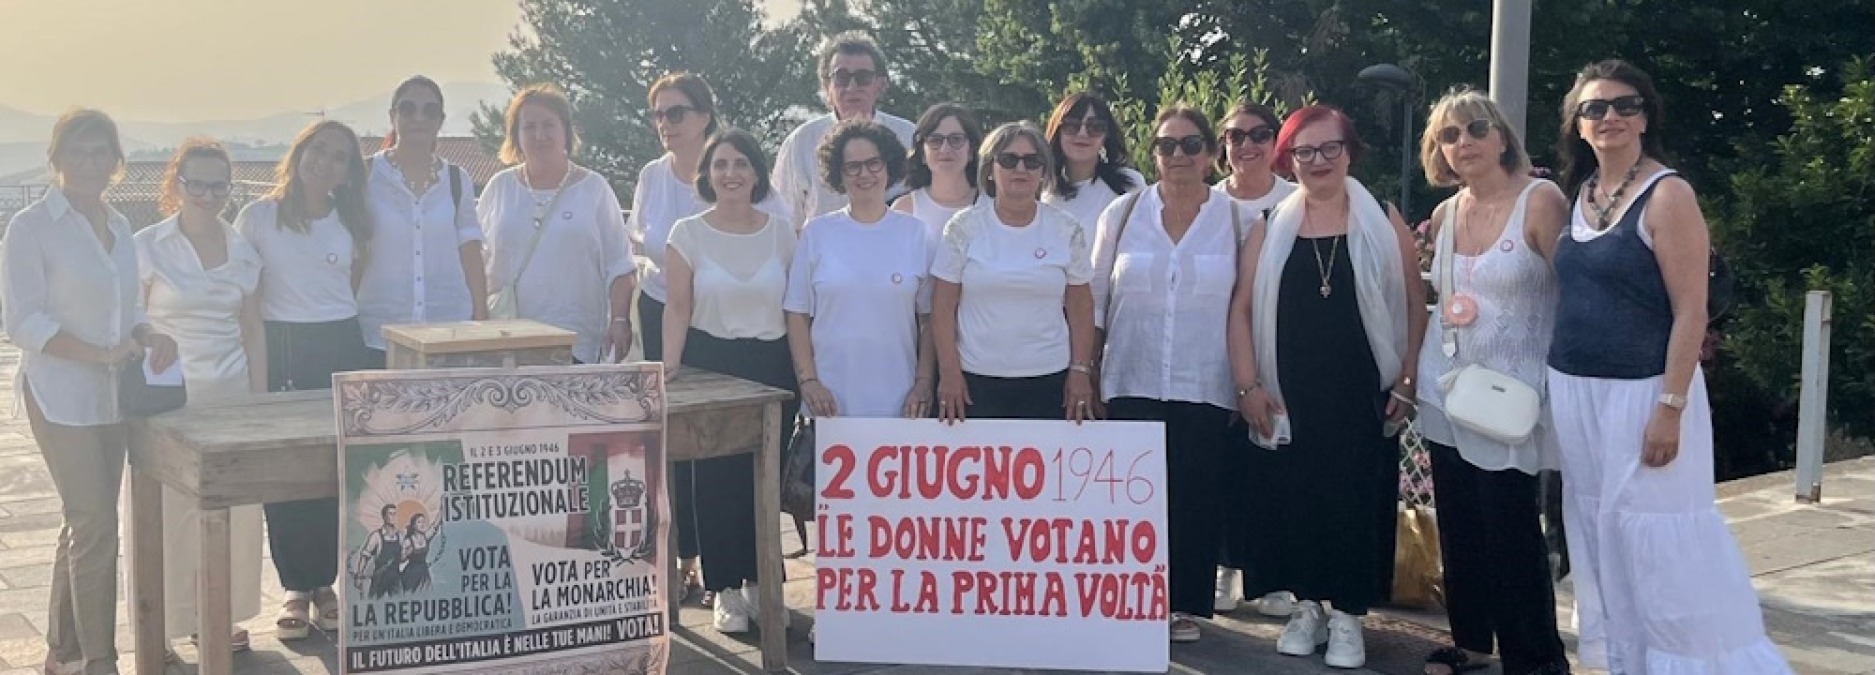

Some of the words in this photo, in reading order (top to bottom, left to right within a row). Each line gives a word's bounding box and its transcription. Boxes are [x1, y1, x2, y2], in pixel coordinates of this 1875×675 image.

[488, 445, 494, 456] E
[443, 457, 586, 491] REFERENDUM
[820, 444, 856, 499] 2
[867, 445, 1045, 500] GIUGNO
[1051, 447, 1154, 504] 1946
[444, 487, 588, 521] ISTITUZIONALE
[867, 514, 987, 561] DONNE
[1001, 517, 1156, 563] VOTANO
[459, 545, 511, 570] VOTA
[532, 560, 578, 585] VOTA
[584, 560, 610, 579] PER
[461, 574, 489, 592] PER
[494, 571, 512, 589] LA
[532, 588, 551, 610] LA
[557, 573, 657, 606] MONARCHIA!
[816, 567, 880, 611] PER
[890, 569, 939, 613] LA
[951, 571, 1067, 616] PRIMA
[352, 604, 377, 627] LA
[385, 592, 512, 625] REPUBBLICA!
[352, 629, 369, 642] PER
[416, 623, 446, 637] LIBERA
[352, 651, 366, 669] IL
[369, 645, 422, 668] FUTURO
[425, 638, 500, 662] DELL'ITALIA
[504, 634, 511, 653] È
[514, 632, 549, 652] NELLE
[551, 629, 574, 647] TUE
[616, 614, 660, 640] VOTA!
